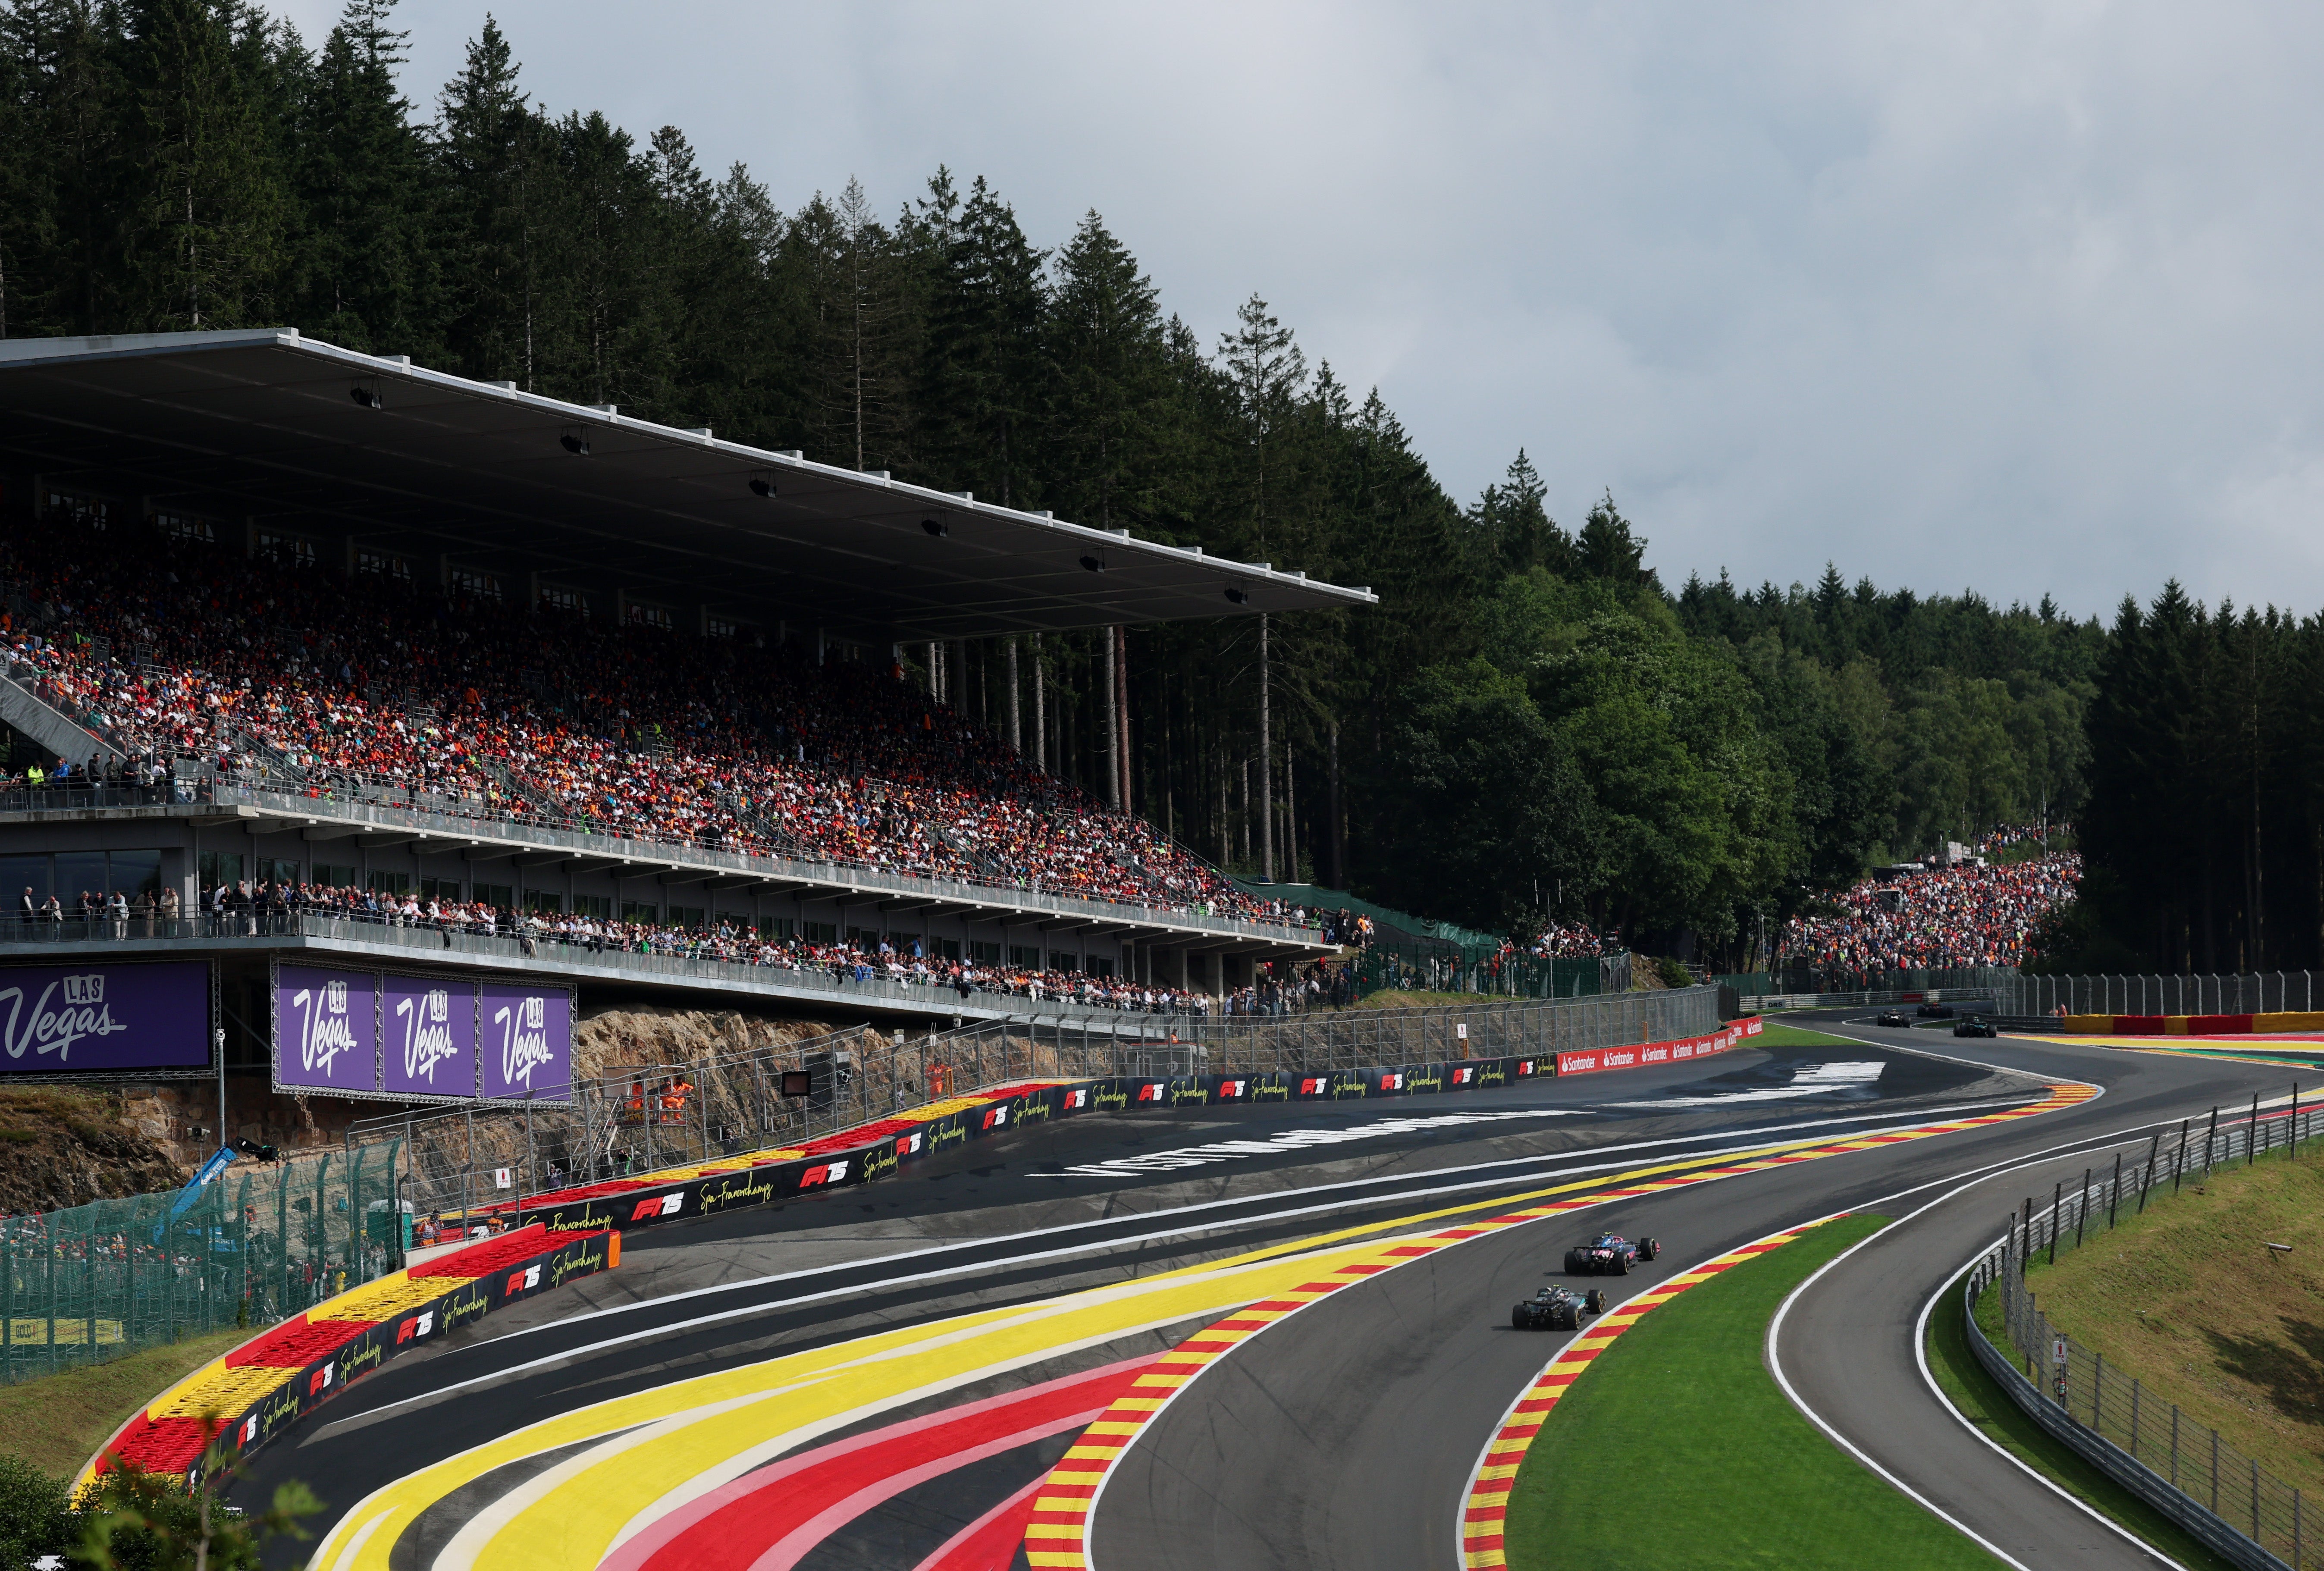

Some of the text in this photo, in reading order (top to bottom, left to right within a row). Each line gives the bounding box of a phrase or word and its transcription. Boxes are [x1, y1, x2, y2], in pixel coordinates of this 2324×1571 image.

[65, 975, 103, 1003] LAS
[329, 983, 346, 1012] LAS
[430, 992, 446, 1020] LAS
[527, 999, 543, 1027] LAS
[0, 981, 127, 1061] Vegas
[294, 986, 357, 1078] Vegas
[397, 994, 458, 1085] Vegas
[495, 1002, 553, 1090] Vegas
[1677, 1043, 1693, 1057] Santander
[1568, 1055, 1595, 1071] Santander
[1609, 1051, 1634, 1066] Santander
[1647, 1047, 1667, 1061] Santander
[525, 1202, 613, 1230] -Francorchamps
[16, 1324, 31, 1338] GOLD
